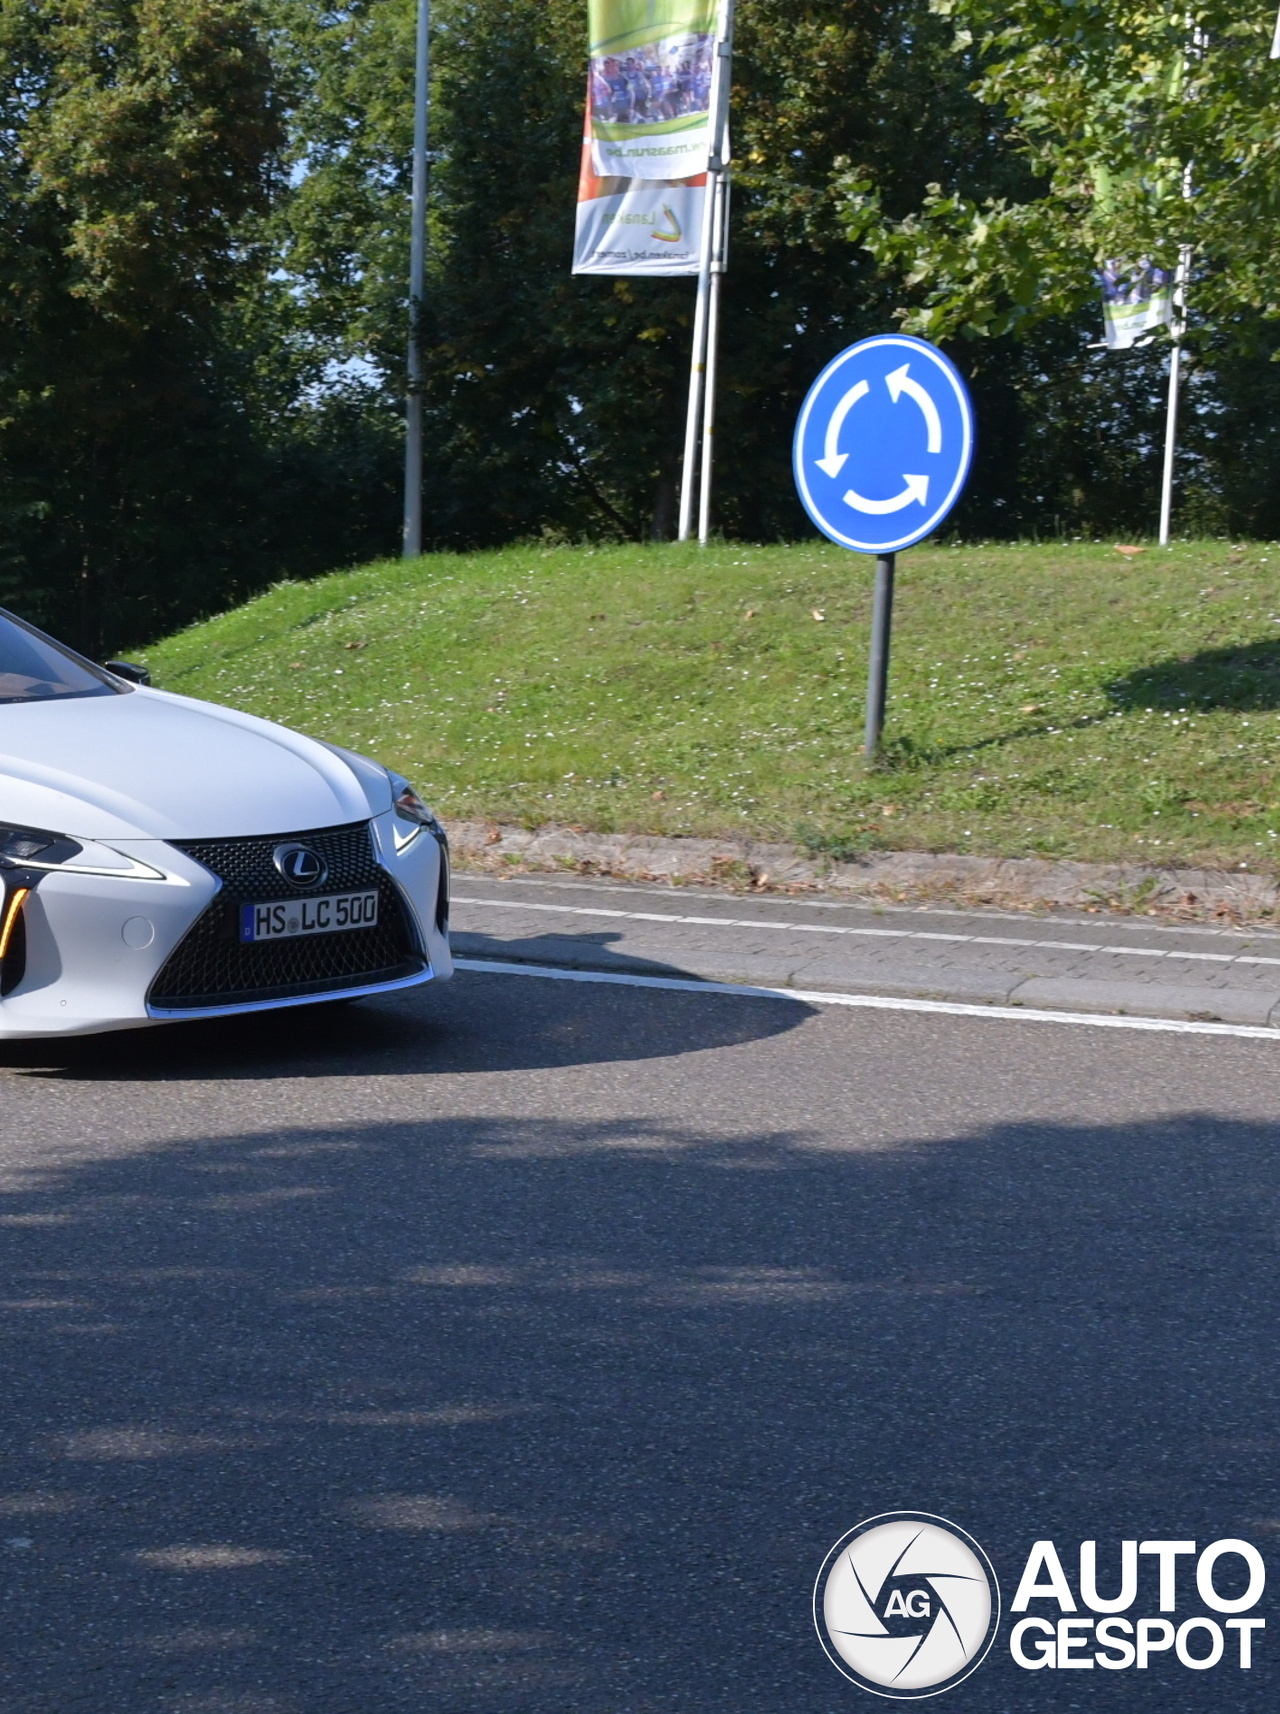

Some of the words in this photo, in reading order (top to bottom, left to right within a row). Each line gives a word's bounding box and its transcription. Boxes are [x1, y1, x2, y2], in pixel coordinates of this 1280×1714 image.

[256, 905, 286, 936] HS
[302, 900, 330, 930] LC
[336, 895, 376, 926] 500
